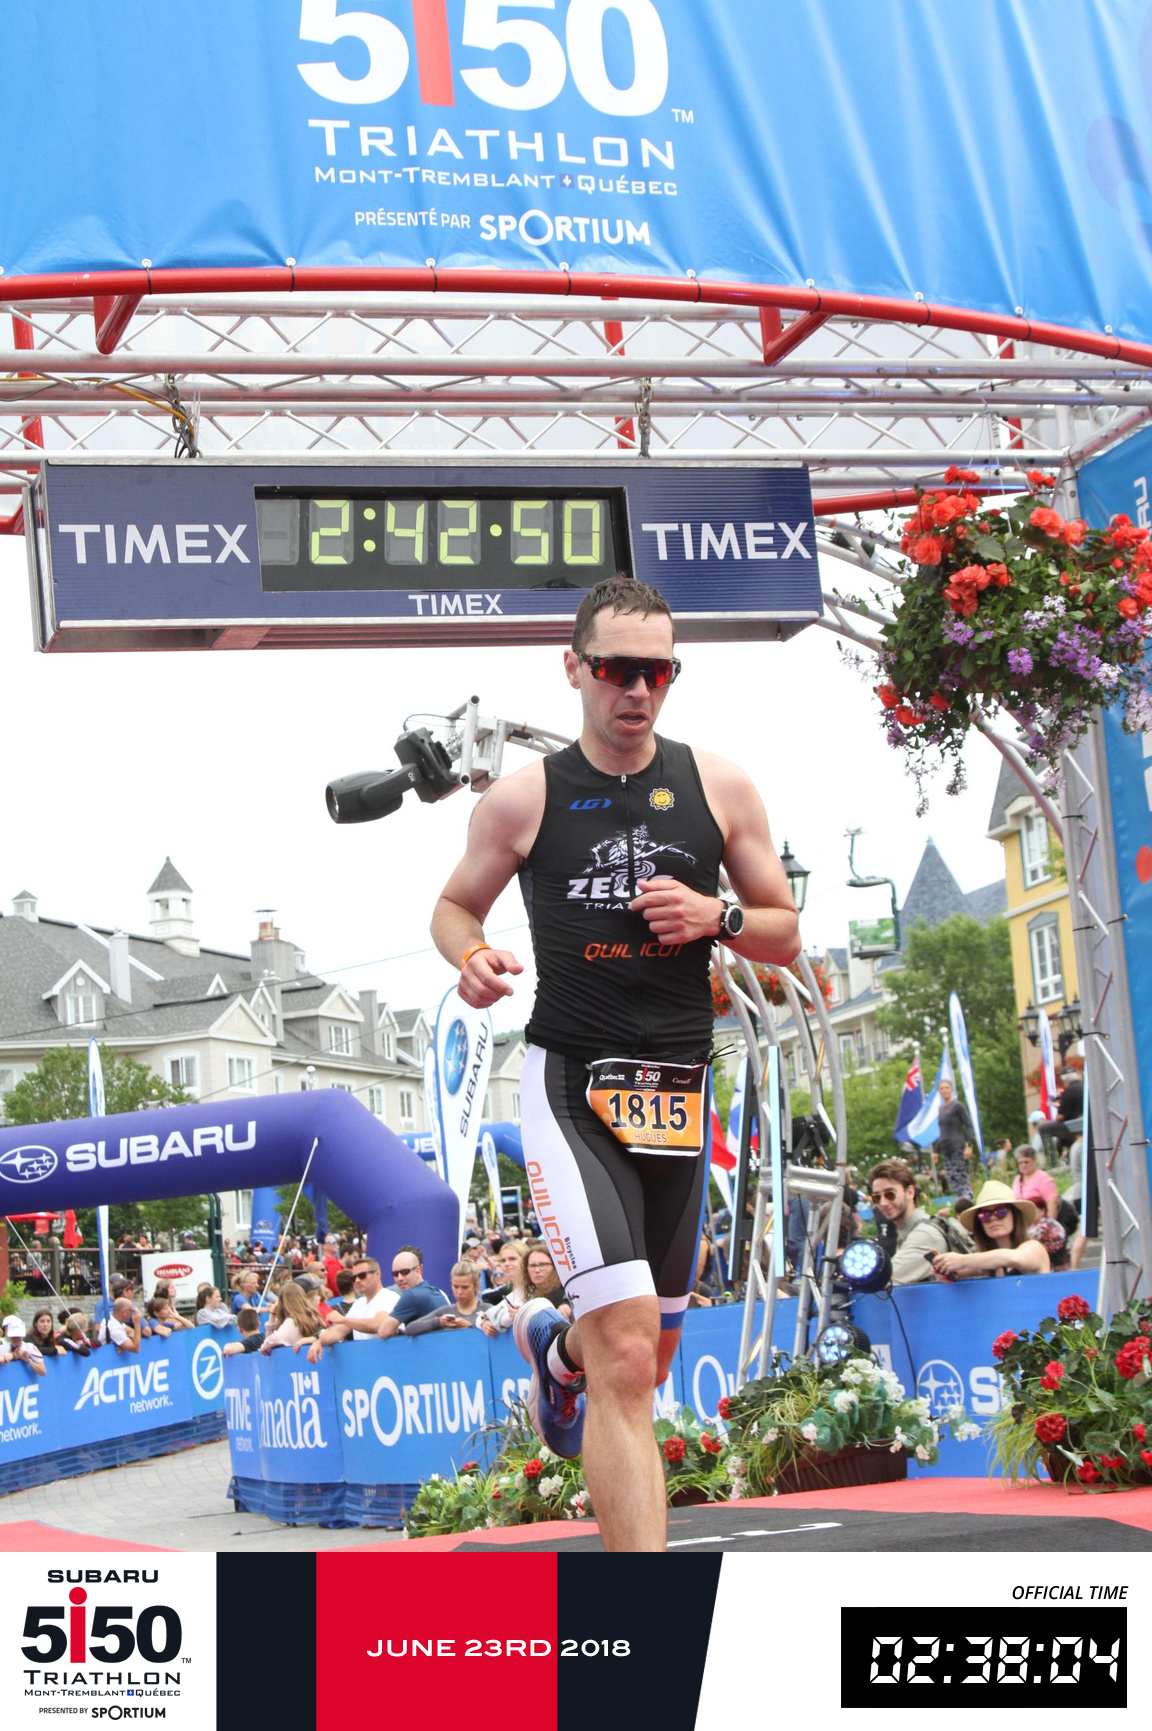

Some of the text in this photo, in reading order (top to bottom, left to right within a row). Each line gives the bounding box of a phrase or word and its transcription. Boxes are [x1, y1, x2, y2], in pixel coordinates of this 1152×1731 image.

[308, 119, 675, 170] TRIATHLON
[314, 166, 678, 197] MONT-TREMBLANT QUÉBEC
[354, 207, 651, 246] PRÉSENTÉ PAR SPORTIUM
[59, 523, 251, 565] TIMEX
[641, 521, 812, 561] TIMEX
[408, 593, 504, 616] TIMEX
[566, 875, 675, 899] ZEU
[459, 1021, 489, 1138] SUBARU
[608, 1092, 688, 1131] 1815
[66, 1120, 257, 1172] SUBARU
[635, 1132, 668, 1143] HUGUES
[526, 1161, 572, 1272] QUILICOT
[563, 1236, 578, 1270] Bicycles
[74, 1359, 170, 1411] ACTIVE
[342, 1376, 486, 1447] SPORTIUM
